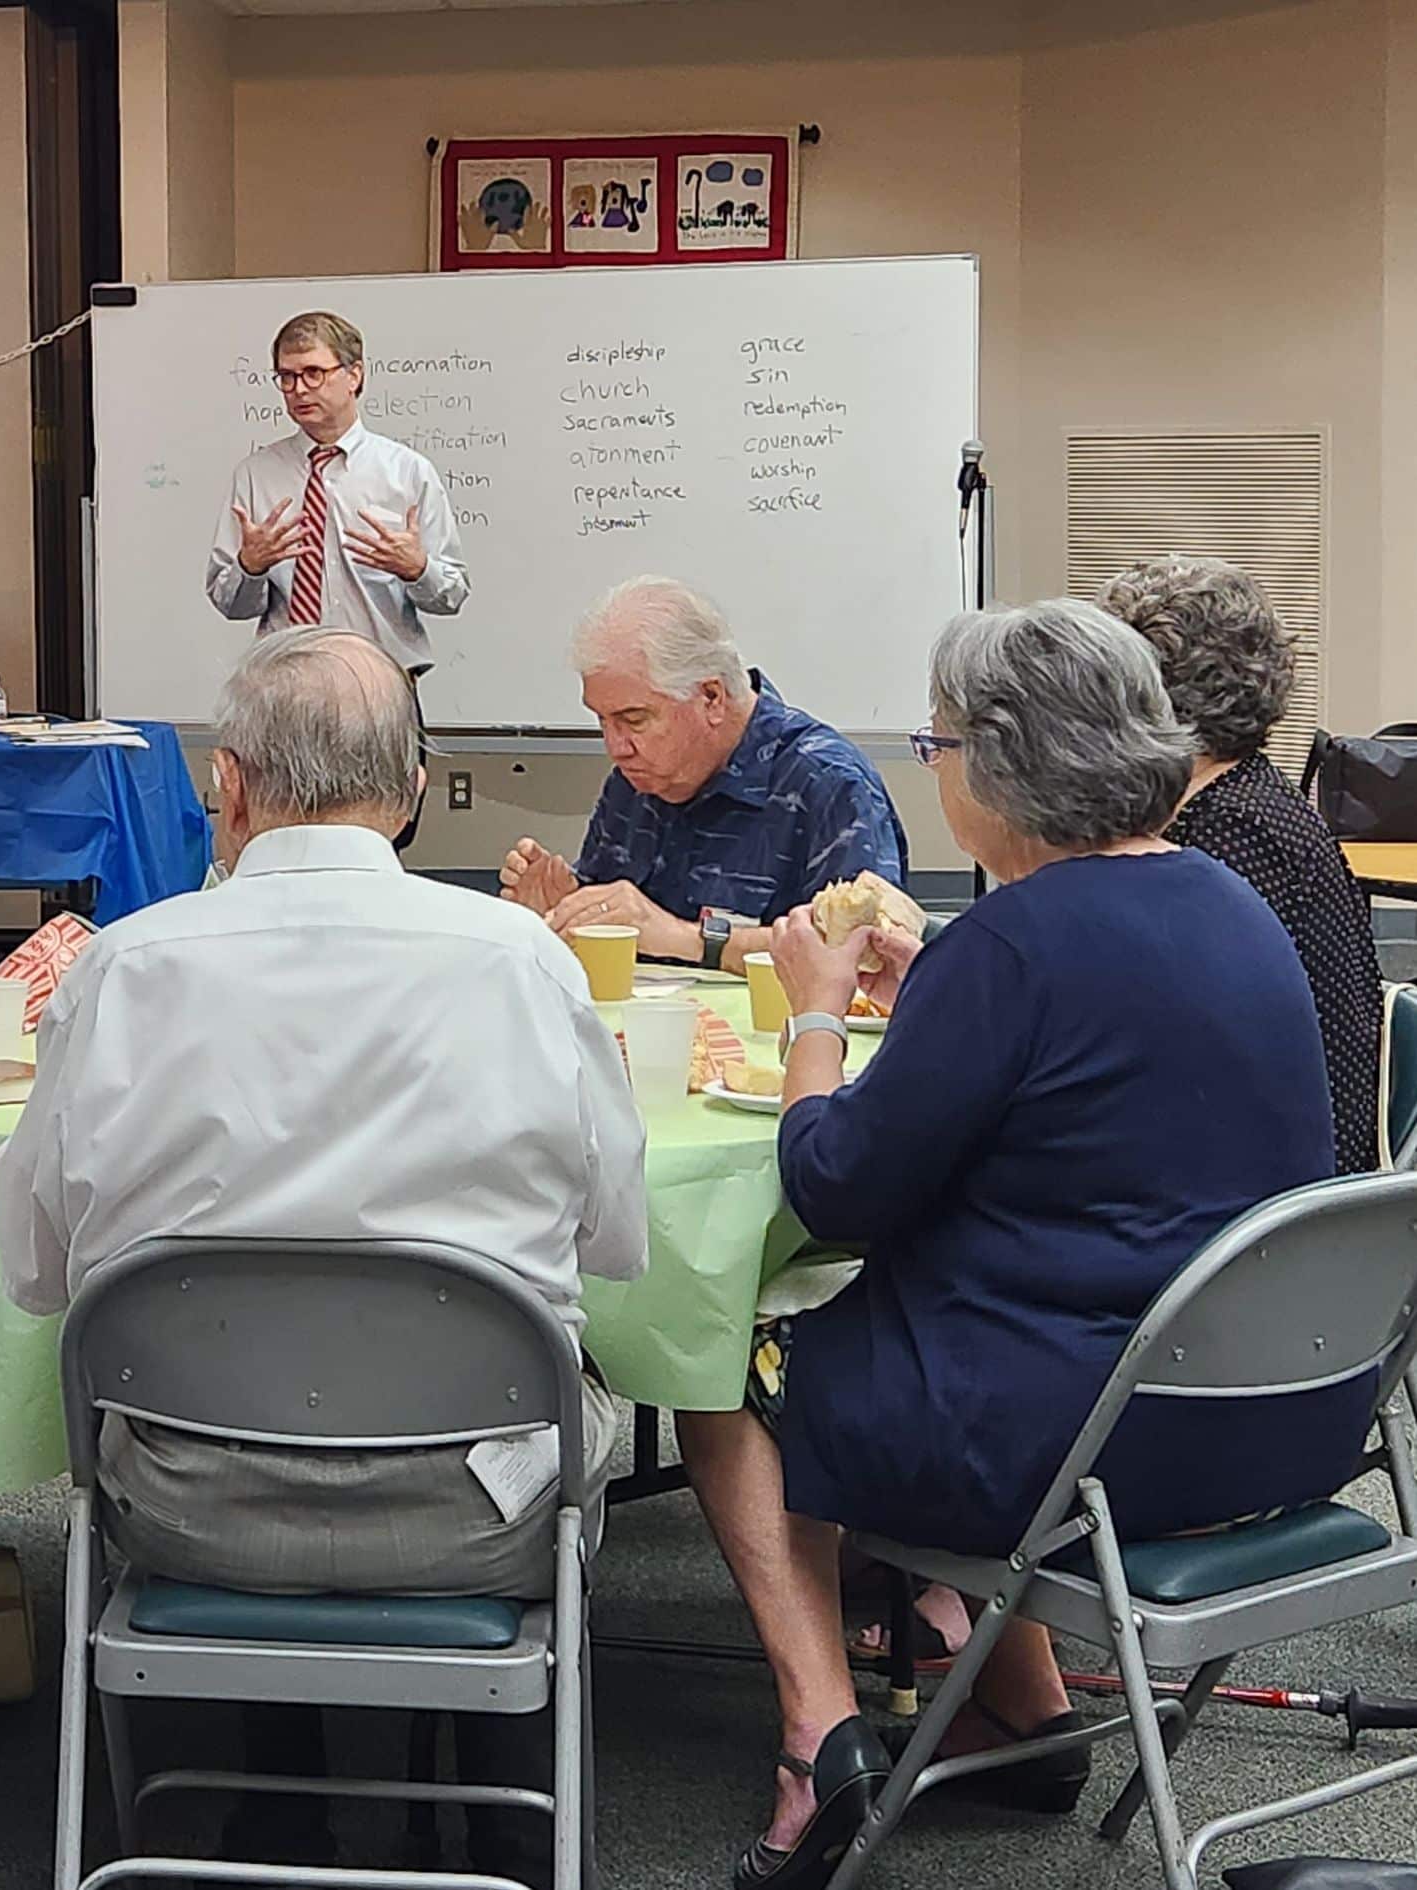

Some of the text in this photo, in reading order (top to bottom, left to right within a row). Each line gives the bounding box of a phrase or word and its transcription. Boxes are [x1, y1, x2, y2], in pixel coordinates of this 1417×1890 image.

[366, 349, 493, 376] incarnation
[566, 338, 666, 367] discipleship
[740, 337, 805, 364] grace
[229, 355, 277, 386] fai
[744, 367, 789, 385] sin
[243, 401, 284, 427] hop
[363, 386, 473, 418] election
[743, 393, 847, 420] redemption
[391, 424, 507, 451] stification
[743, 423, 844, 454] covenant
[444, 468, 492, 490] tion
[750, 457, 816, 481] worship
[573, 476, 687, 510] repentance
